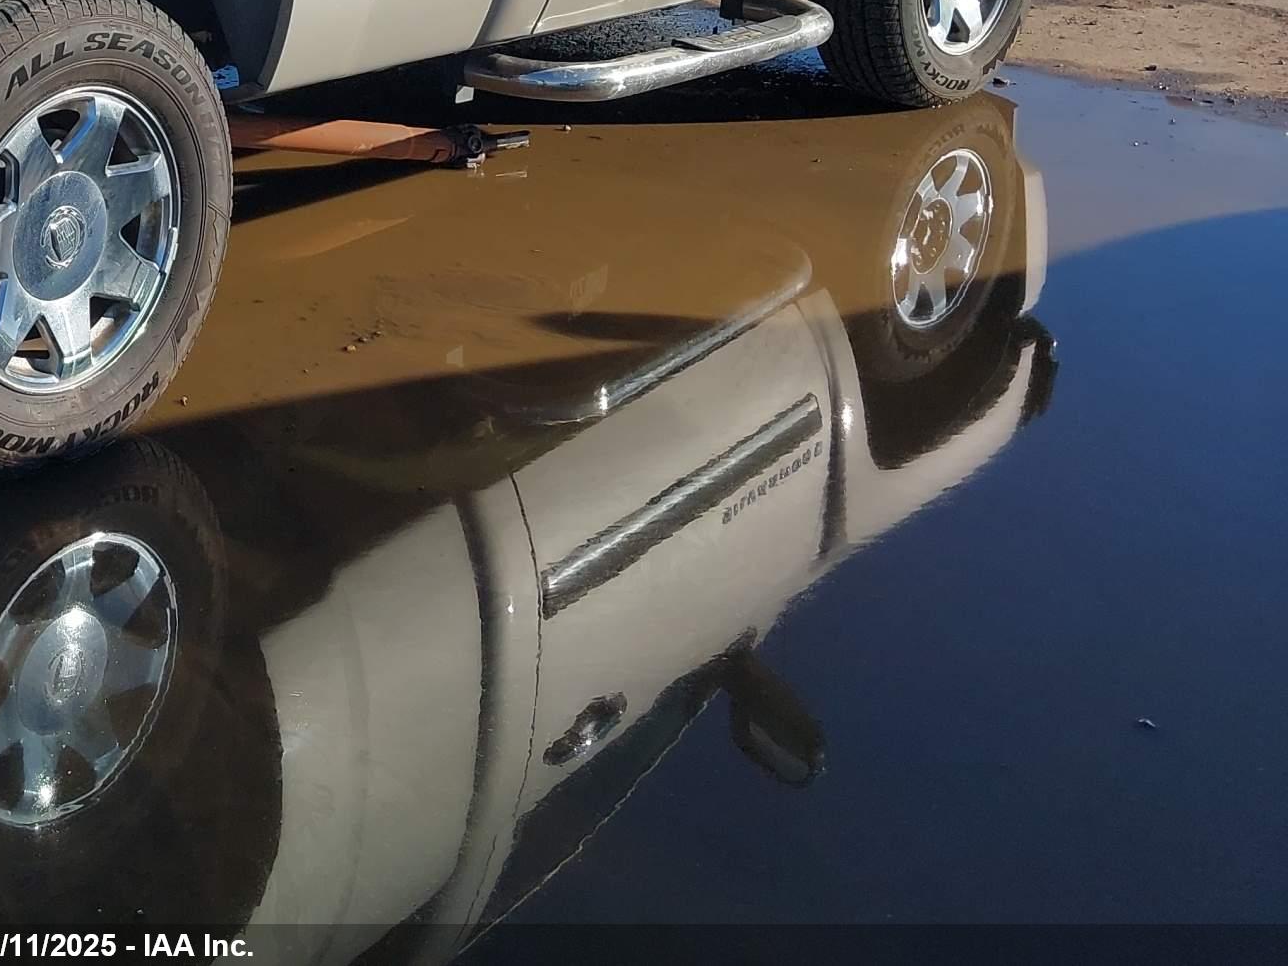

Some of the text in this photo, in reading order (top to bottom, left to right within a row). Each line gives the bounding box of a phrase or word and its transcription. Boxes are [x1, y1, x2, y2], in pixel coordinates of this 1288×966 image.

[5, 32, 206, 106] ALL SEASON
[920, 60, 970, 90] ROCKY
[64, 370, 160, 450] ROCKY
